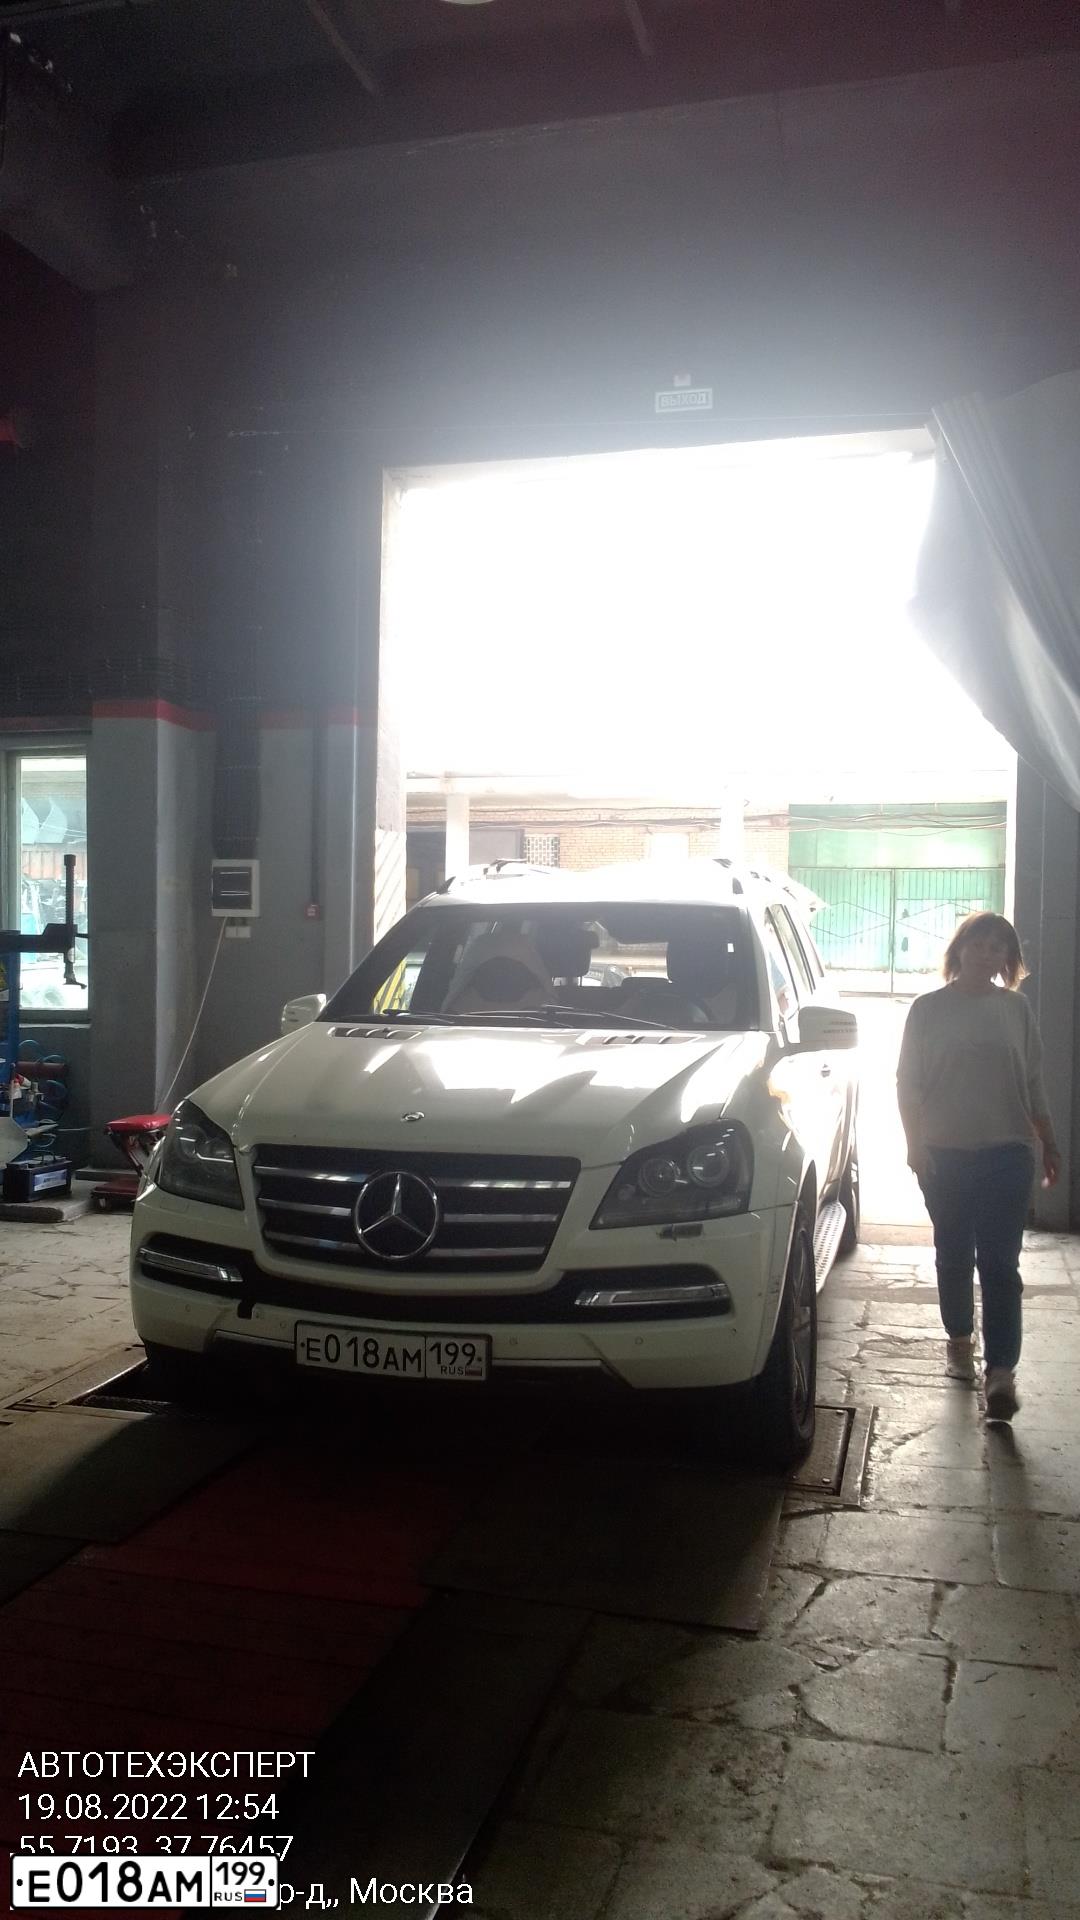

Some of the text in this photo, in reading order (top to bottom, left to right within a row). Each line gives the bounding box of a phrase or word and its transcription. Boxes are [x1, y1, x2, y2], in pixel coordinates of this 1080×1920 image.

[306, 1334, 476, 1372] Е018АМ 199
[440, 1365, 466, 1376] RUS
